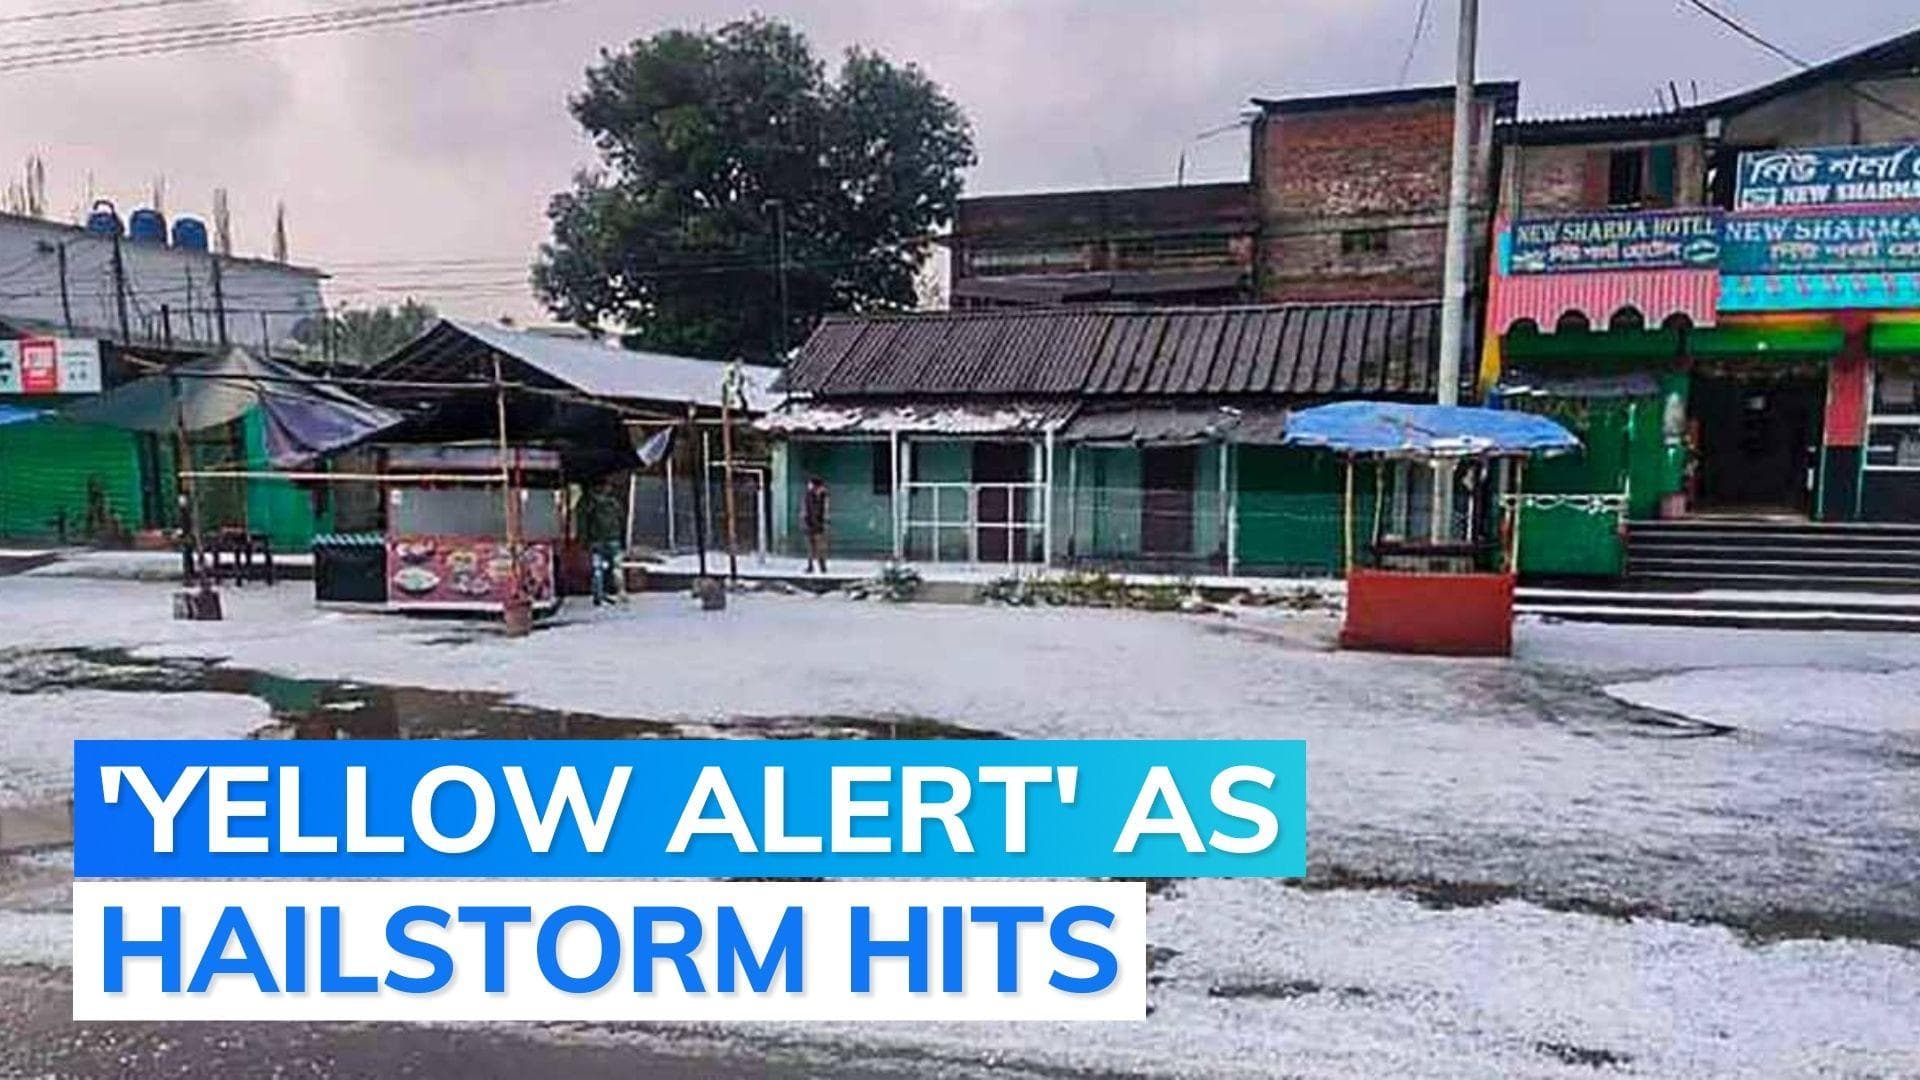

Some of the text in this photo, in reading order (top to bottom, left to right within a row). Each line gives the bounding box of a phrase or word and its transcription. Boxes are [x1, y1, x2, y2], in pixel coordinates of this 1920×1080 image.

[1783, 184, 1830, 204] NEW
[1517, 215, 1716, 245] NEW SHARMA HOTEL
[1725, 219, 1790, 241] NEW
